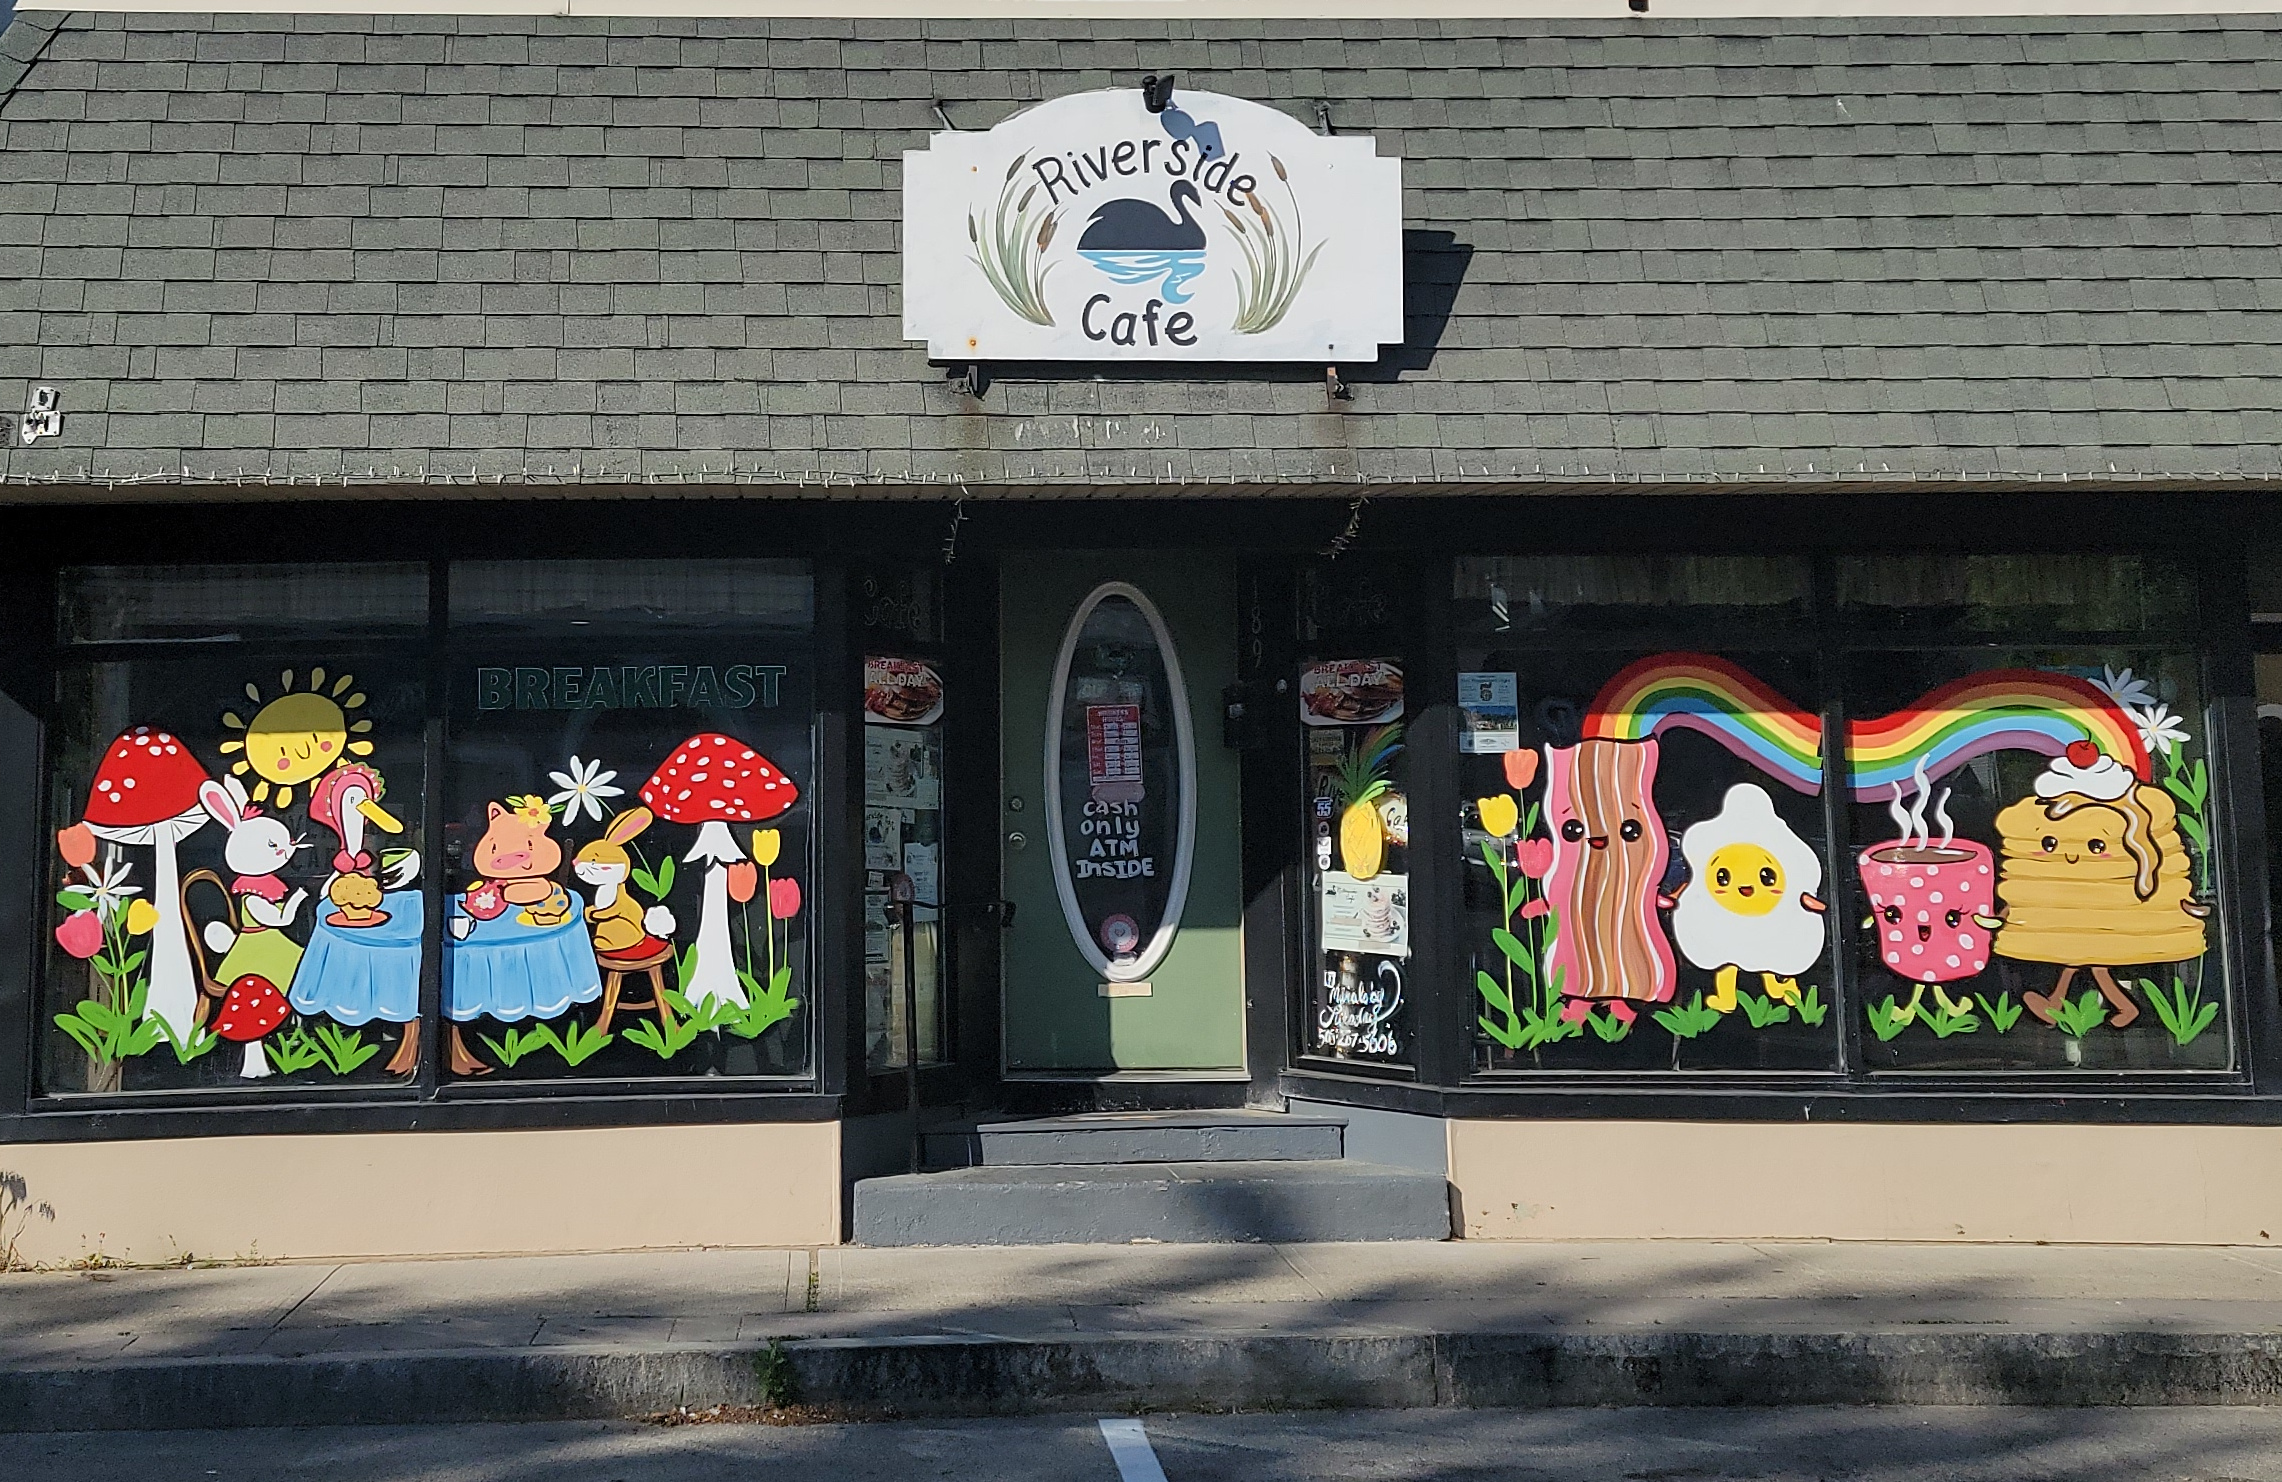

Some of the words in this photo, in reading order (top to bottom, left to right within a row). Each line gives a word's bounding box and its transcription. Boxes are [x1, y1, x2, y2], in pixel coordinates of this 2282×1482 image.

[1031, 139, 1257, 206] Riverside
[1082, 293, 1198, 346] Cafe
[478, 665, 787, 709] BREAKFAST
[870, 671, 897, 685] ALL
[897, 672, 924, 687] DAY
[1350, 673, 1384, 687] DAY
[1090, 838, 1139, 857] ATM
